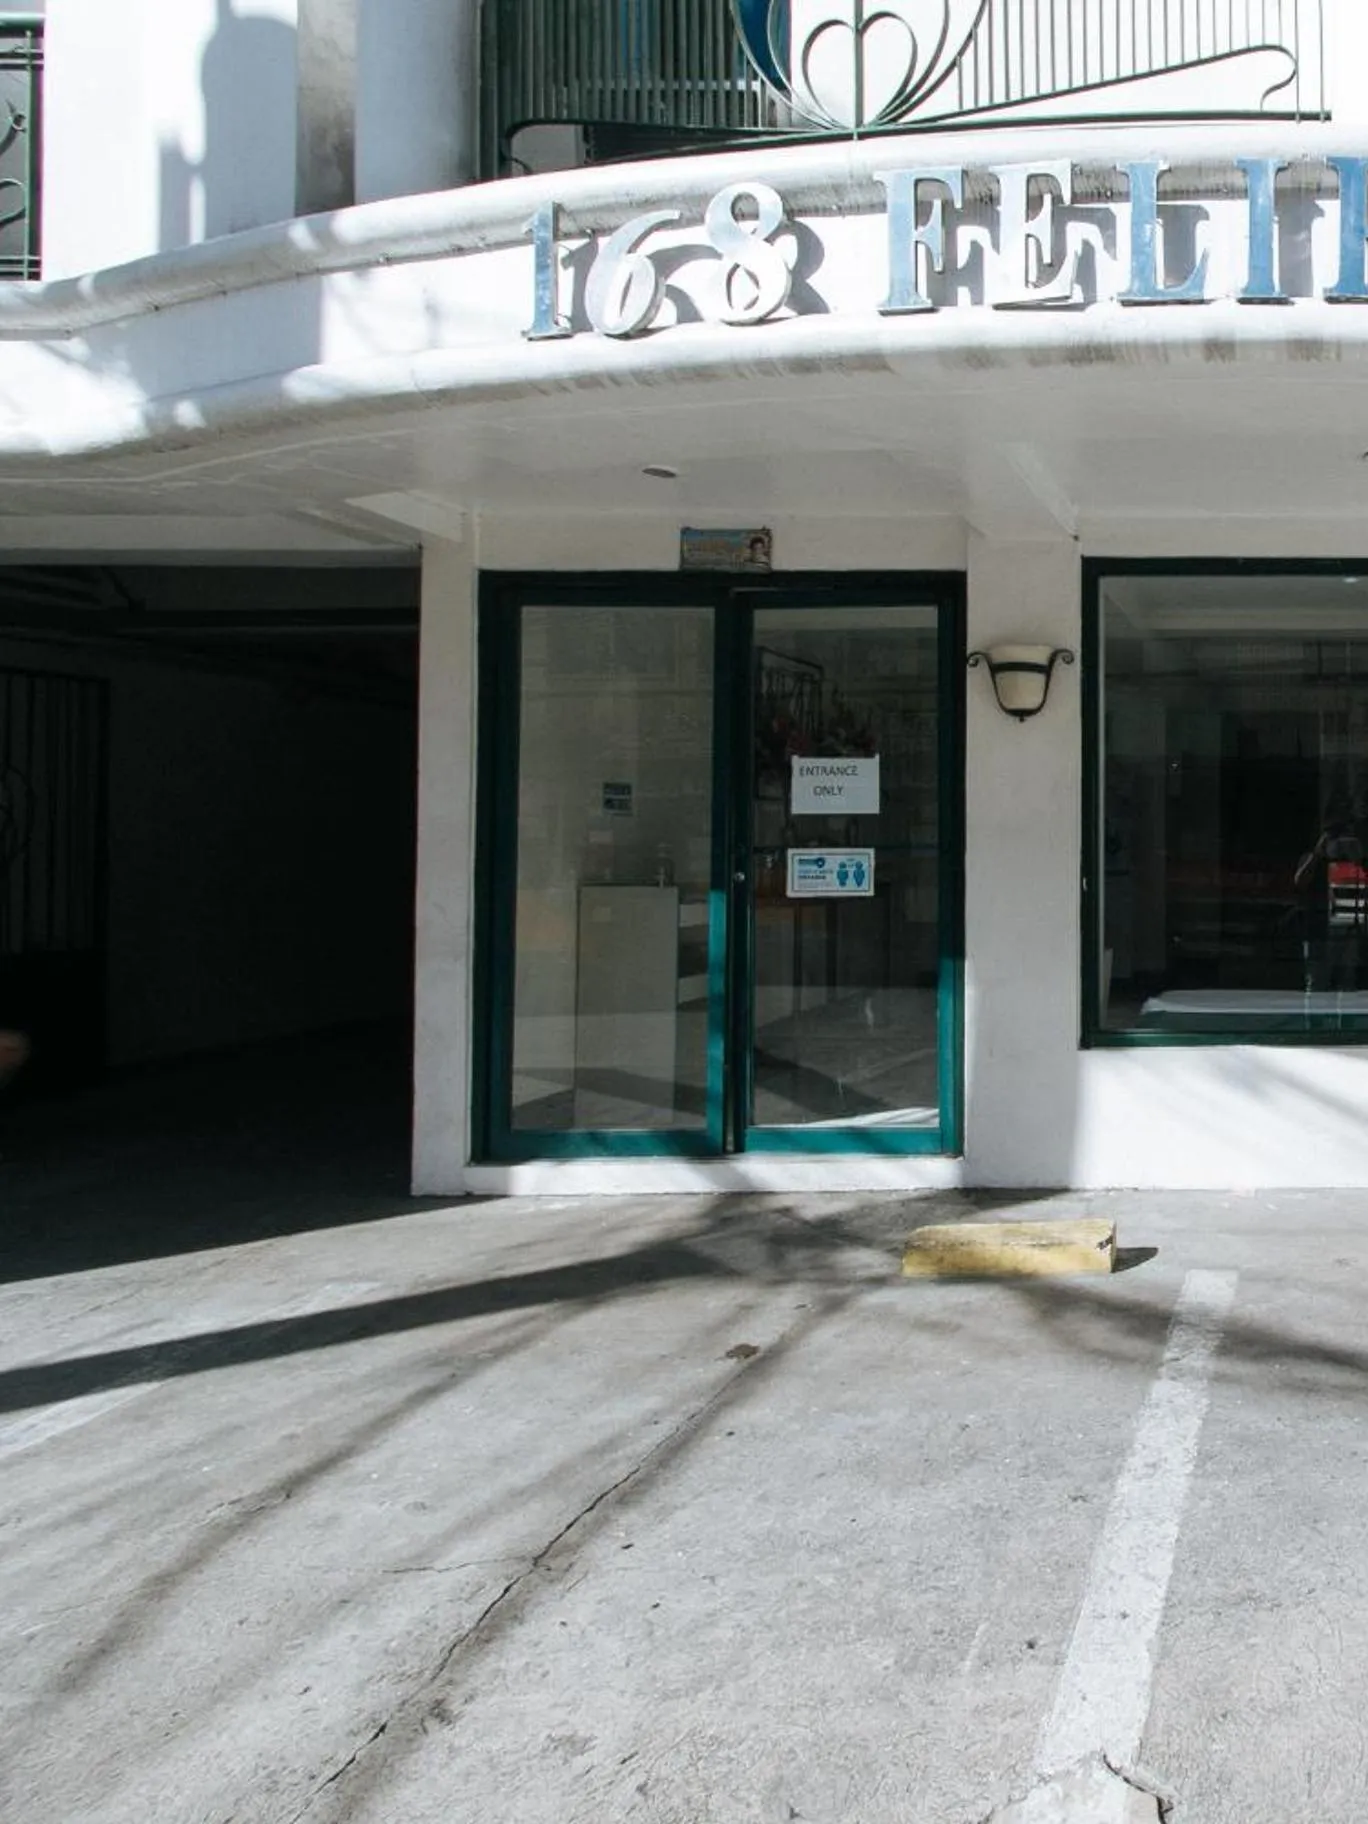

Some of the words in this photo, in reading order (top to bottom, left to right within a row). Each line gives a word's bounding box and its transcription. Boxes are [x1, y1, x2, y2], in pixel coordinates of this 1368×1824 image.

[521, 182, 793, 340] 168
[799, 765, 859, 777] ENTRANCE
[813, 785, 844, 797] ONLY
